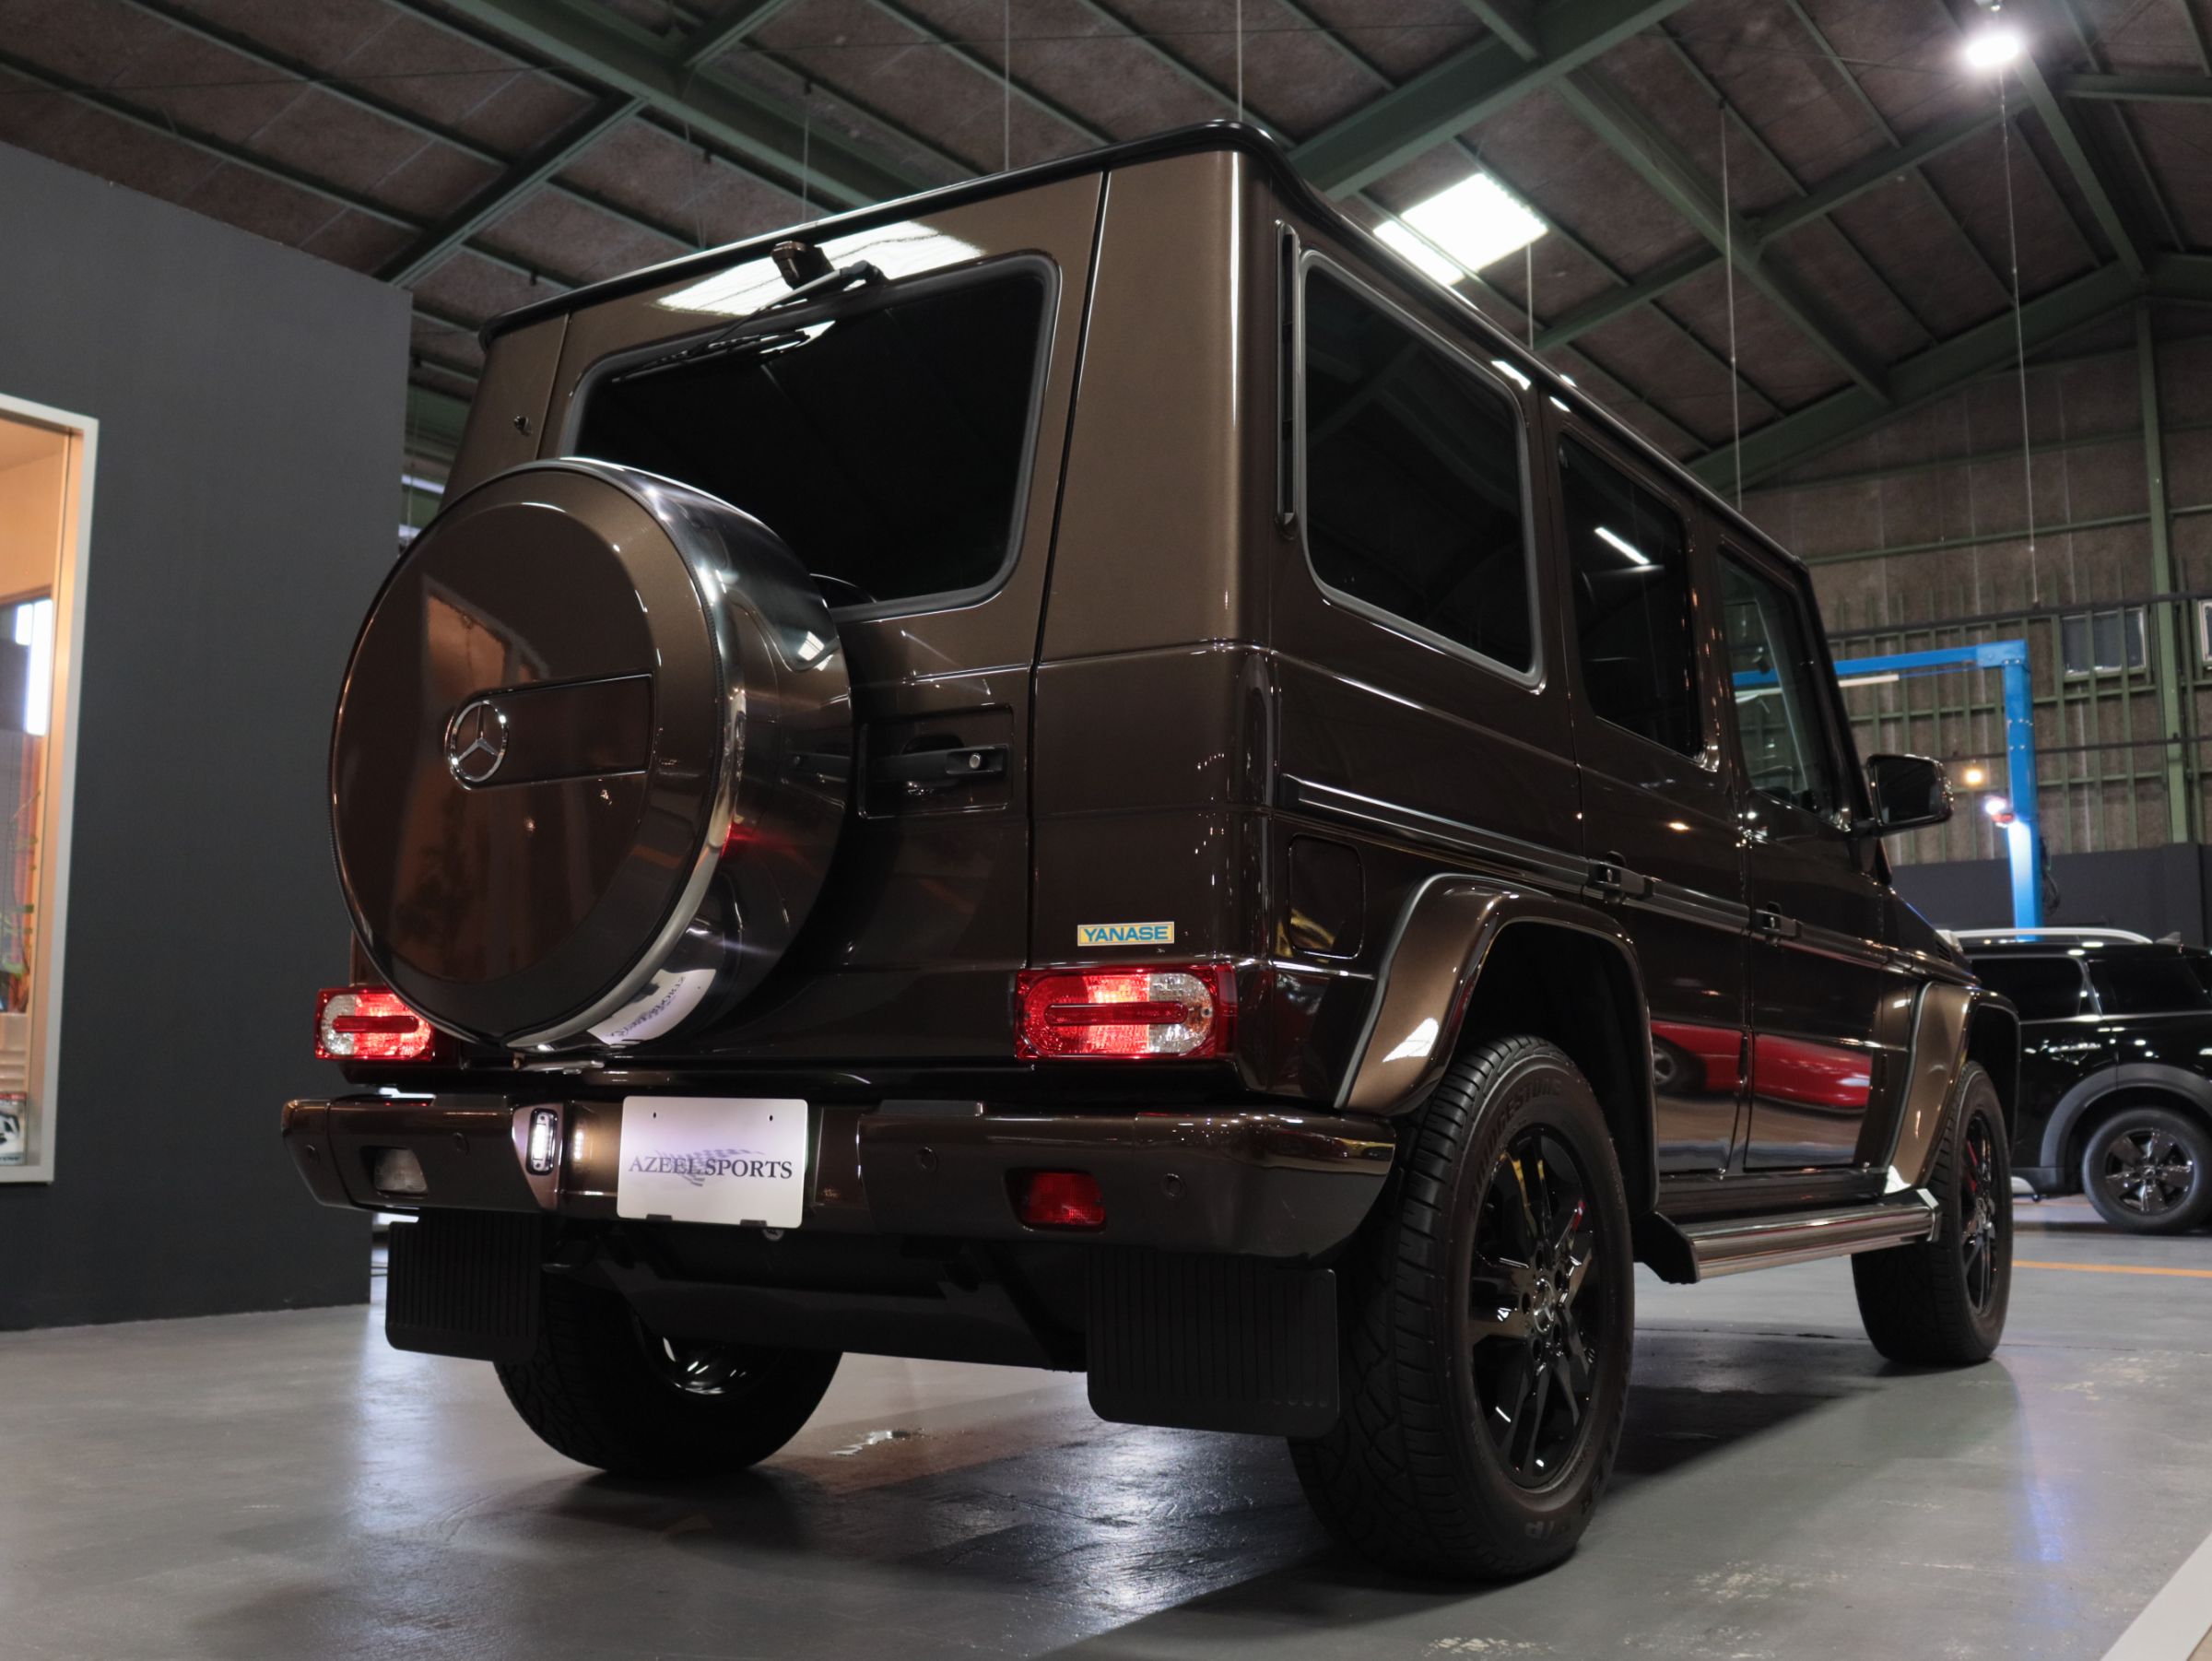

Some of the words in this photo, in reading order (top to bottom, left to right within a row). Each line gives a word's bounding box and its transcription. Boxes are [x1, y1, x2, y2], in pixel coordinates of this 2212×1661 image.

[1084, 926, 1169, 941] YANASE
[629, 1156, 703, 1174] AZEEL
[704, 1159, 793, 1179] SPORTS
